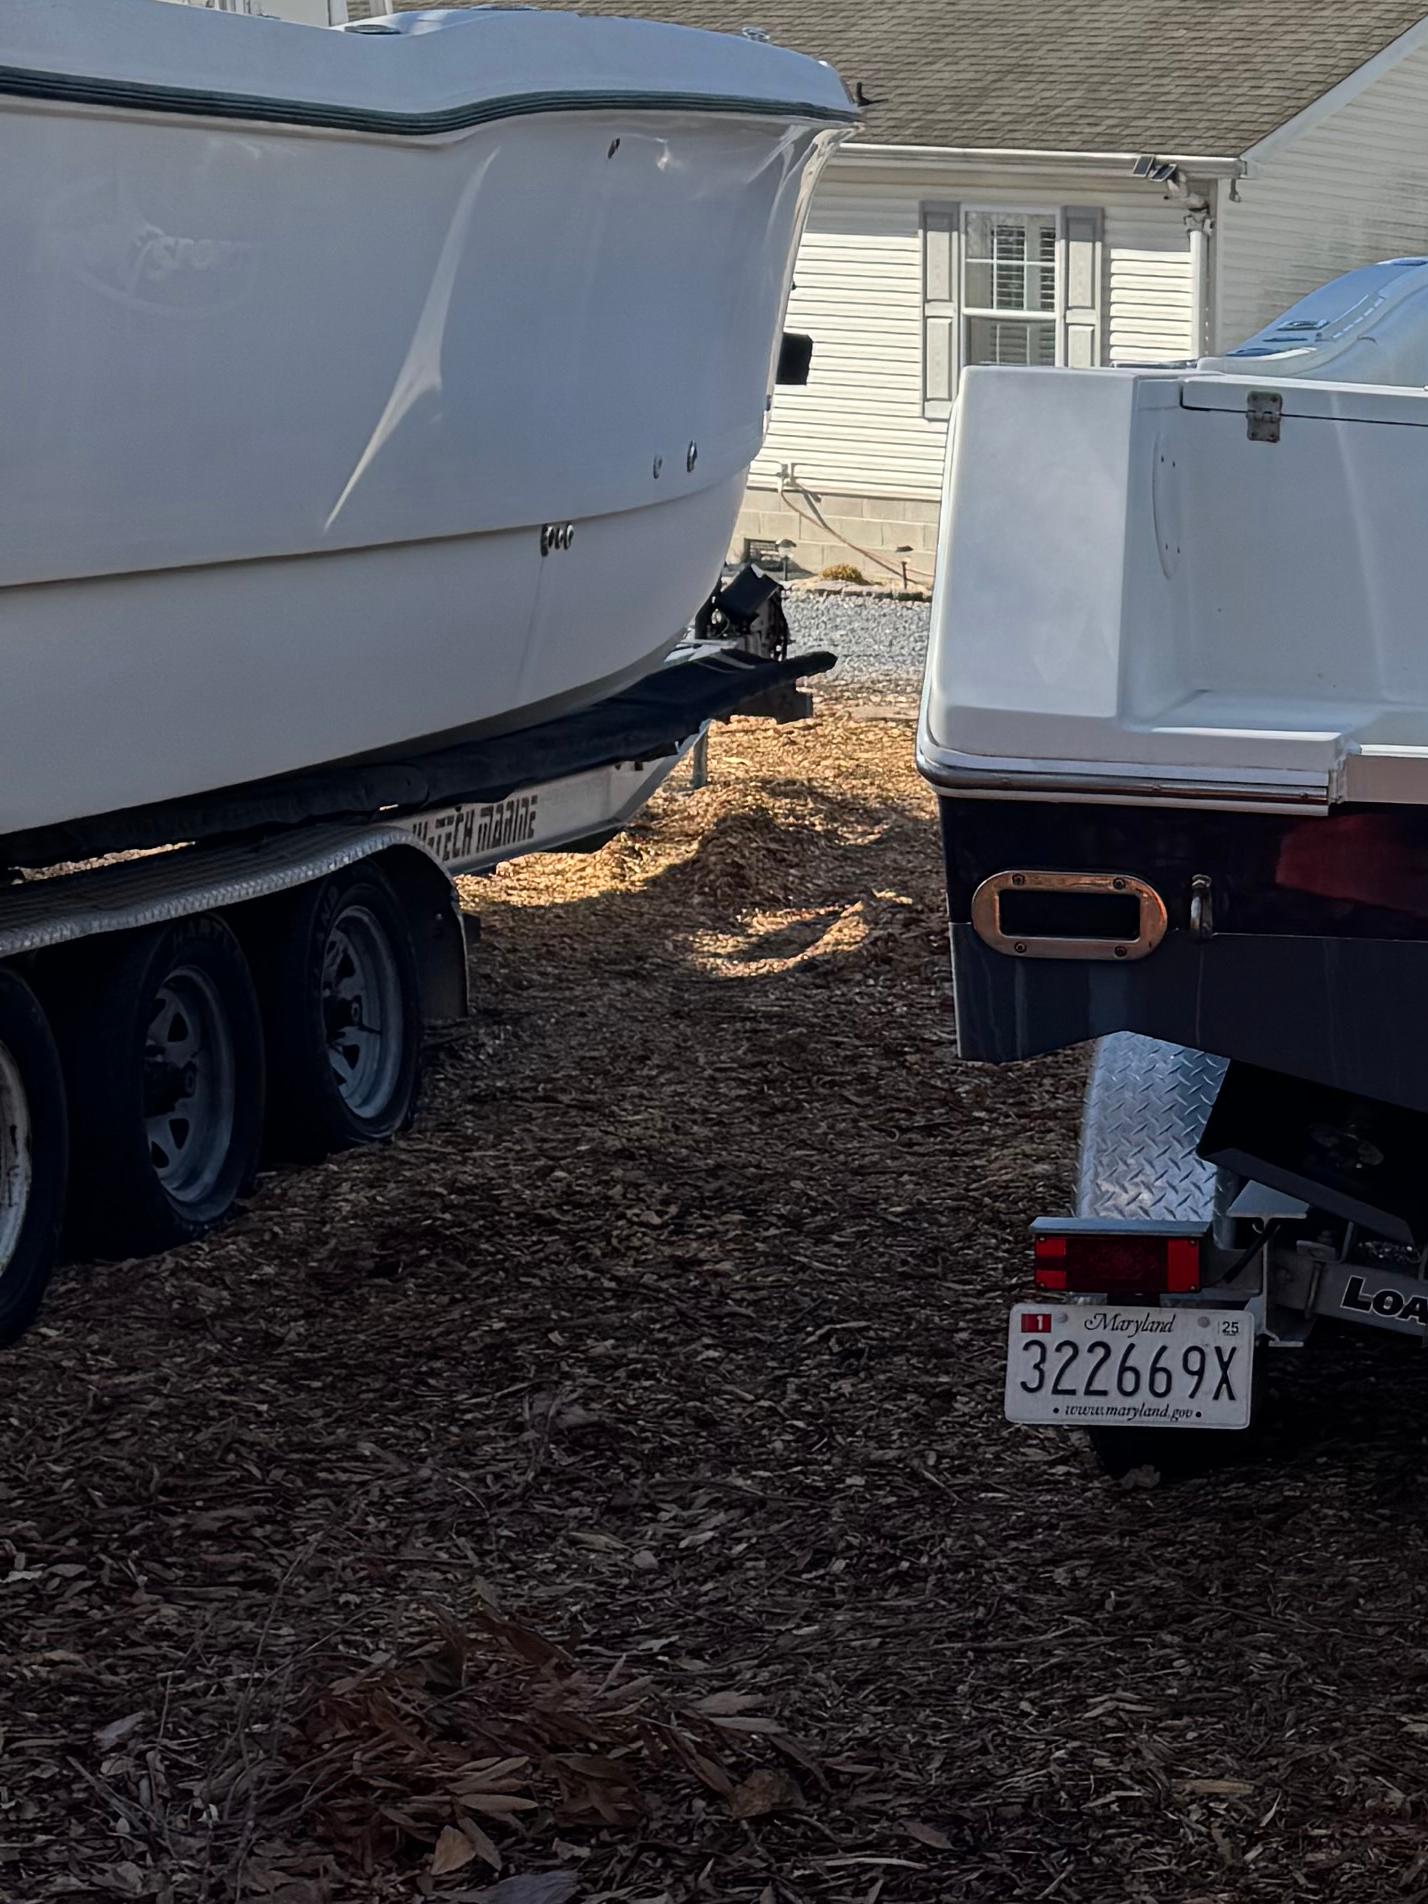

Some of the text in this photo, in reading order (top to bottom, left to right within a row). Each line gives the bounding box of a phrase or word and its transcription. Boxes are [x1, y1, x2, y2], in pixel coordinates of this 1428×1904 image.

[1084, 1312, 1176, 1338] Maryland
[1222, 1320, 1240, 1334] 25
[1020, 1339, 1237, 1401] 322669X
[1065, 1403, 1194, 1421] www.maryland.gov
